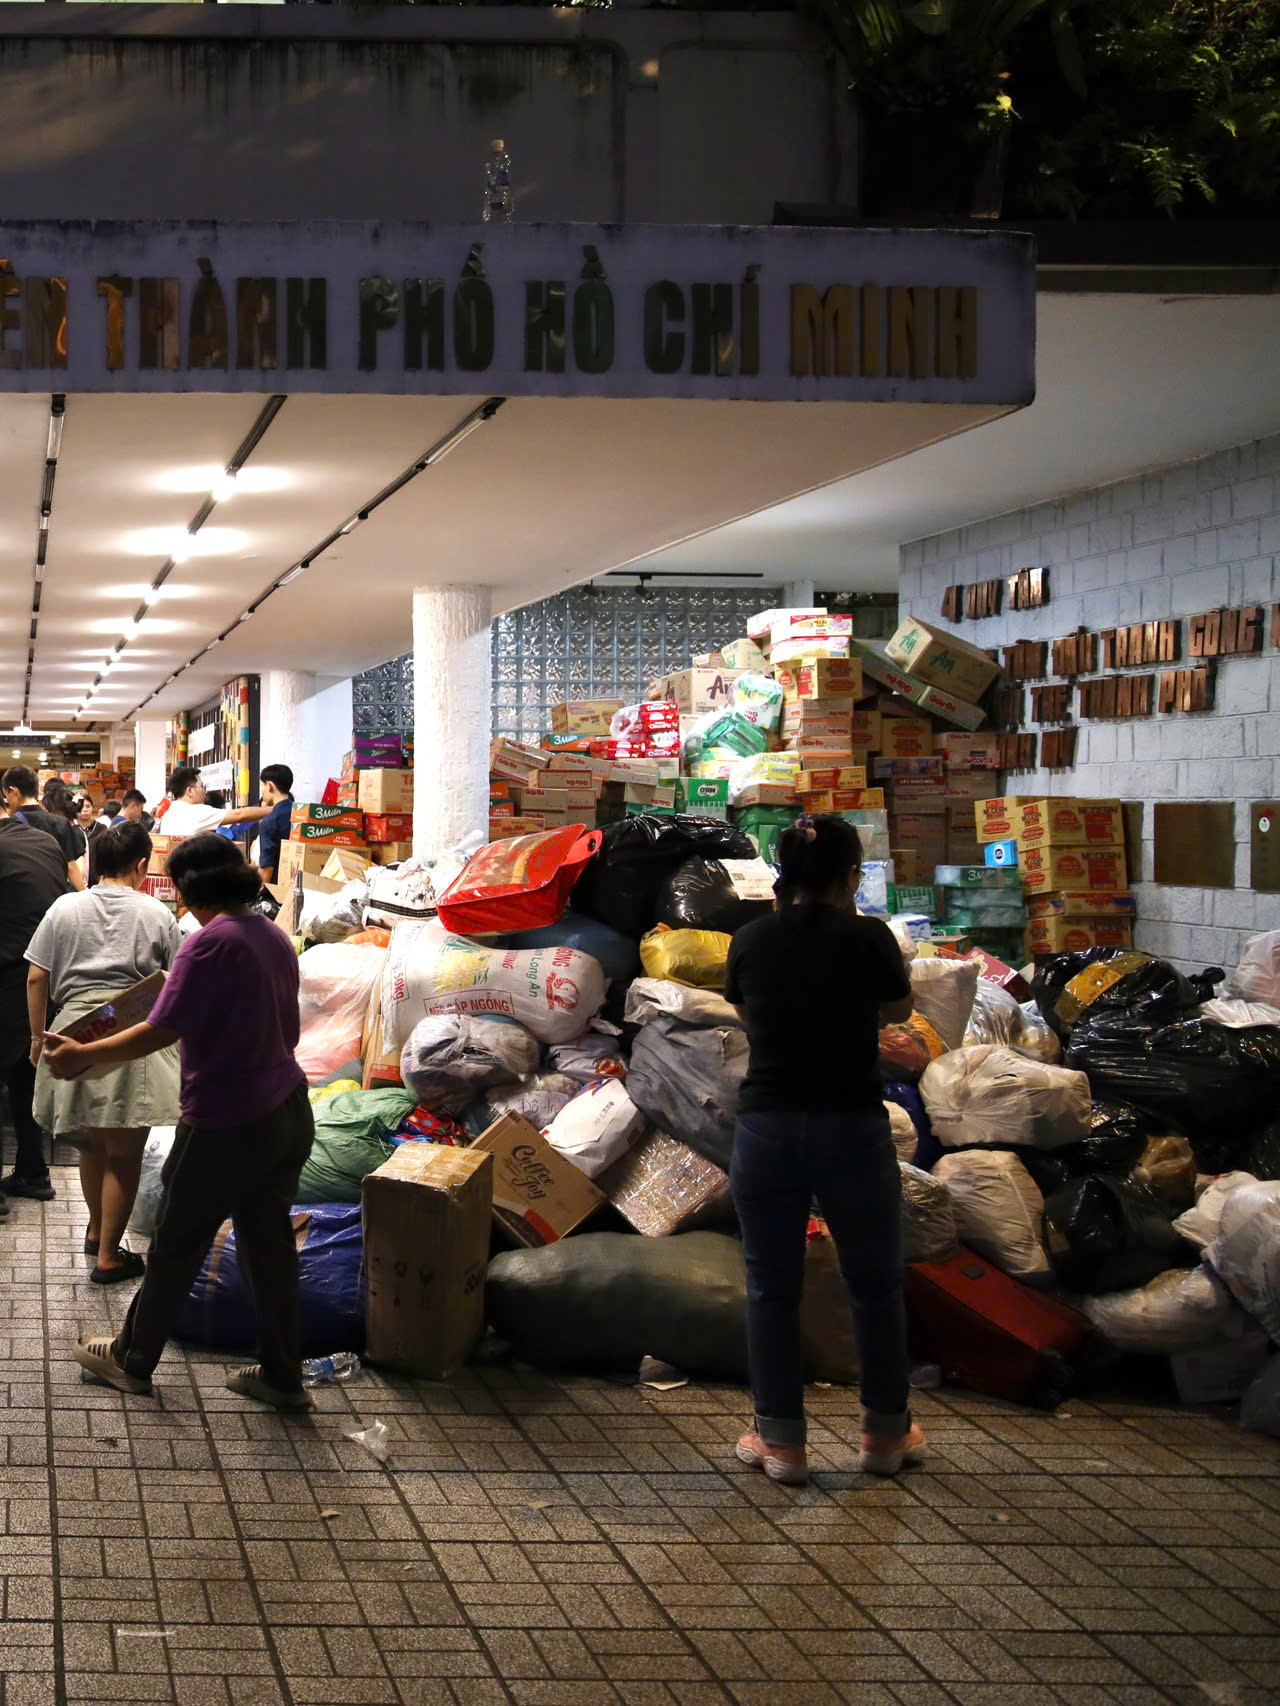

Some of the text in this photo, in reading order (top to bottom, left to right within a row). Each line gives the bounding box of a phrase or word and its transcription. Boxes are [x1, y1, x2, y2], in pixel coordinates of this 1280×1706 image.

[97, 257, 326, 371] THÀNH
[359, 243, 494, 373] PHỐ
[524, 245, 615, 374] HỒ
[644, 265, 761, 377] CHÍ
[790, 284, 979, 379] MINH
[940, 585, 962, 622] 4
[1100, 620, 1181, 669] TRANH
[1189, 606, 1264, 658] CÔNG
[528, 982, 542, 998] An
[512, 1144, 555, 1186] Coffee
[512, 1175, 546, 1200] Joy
